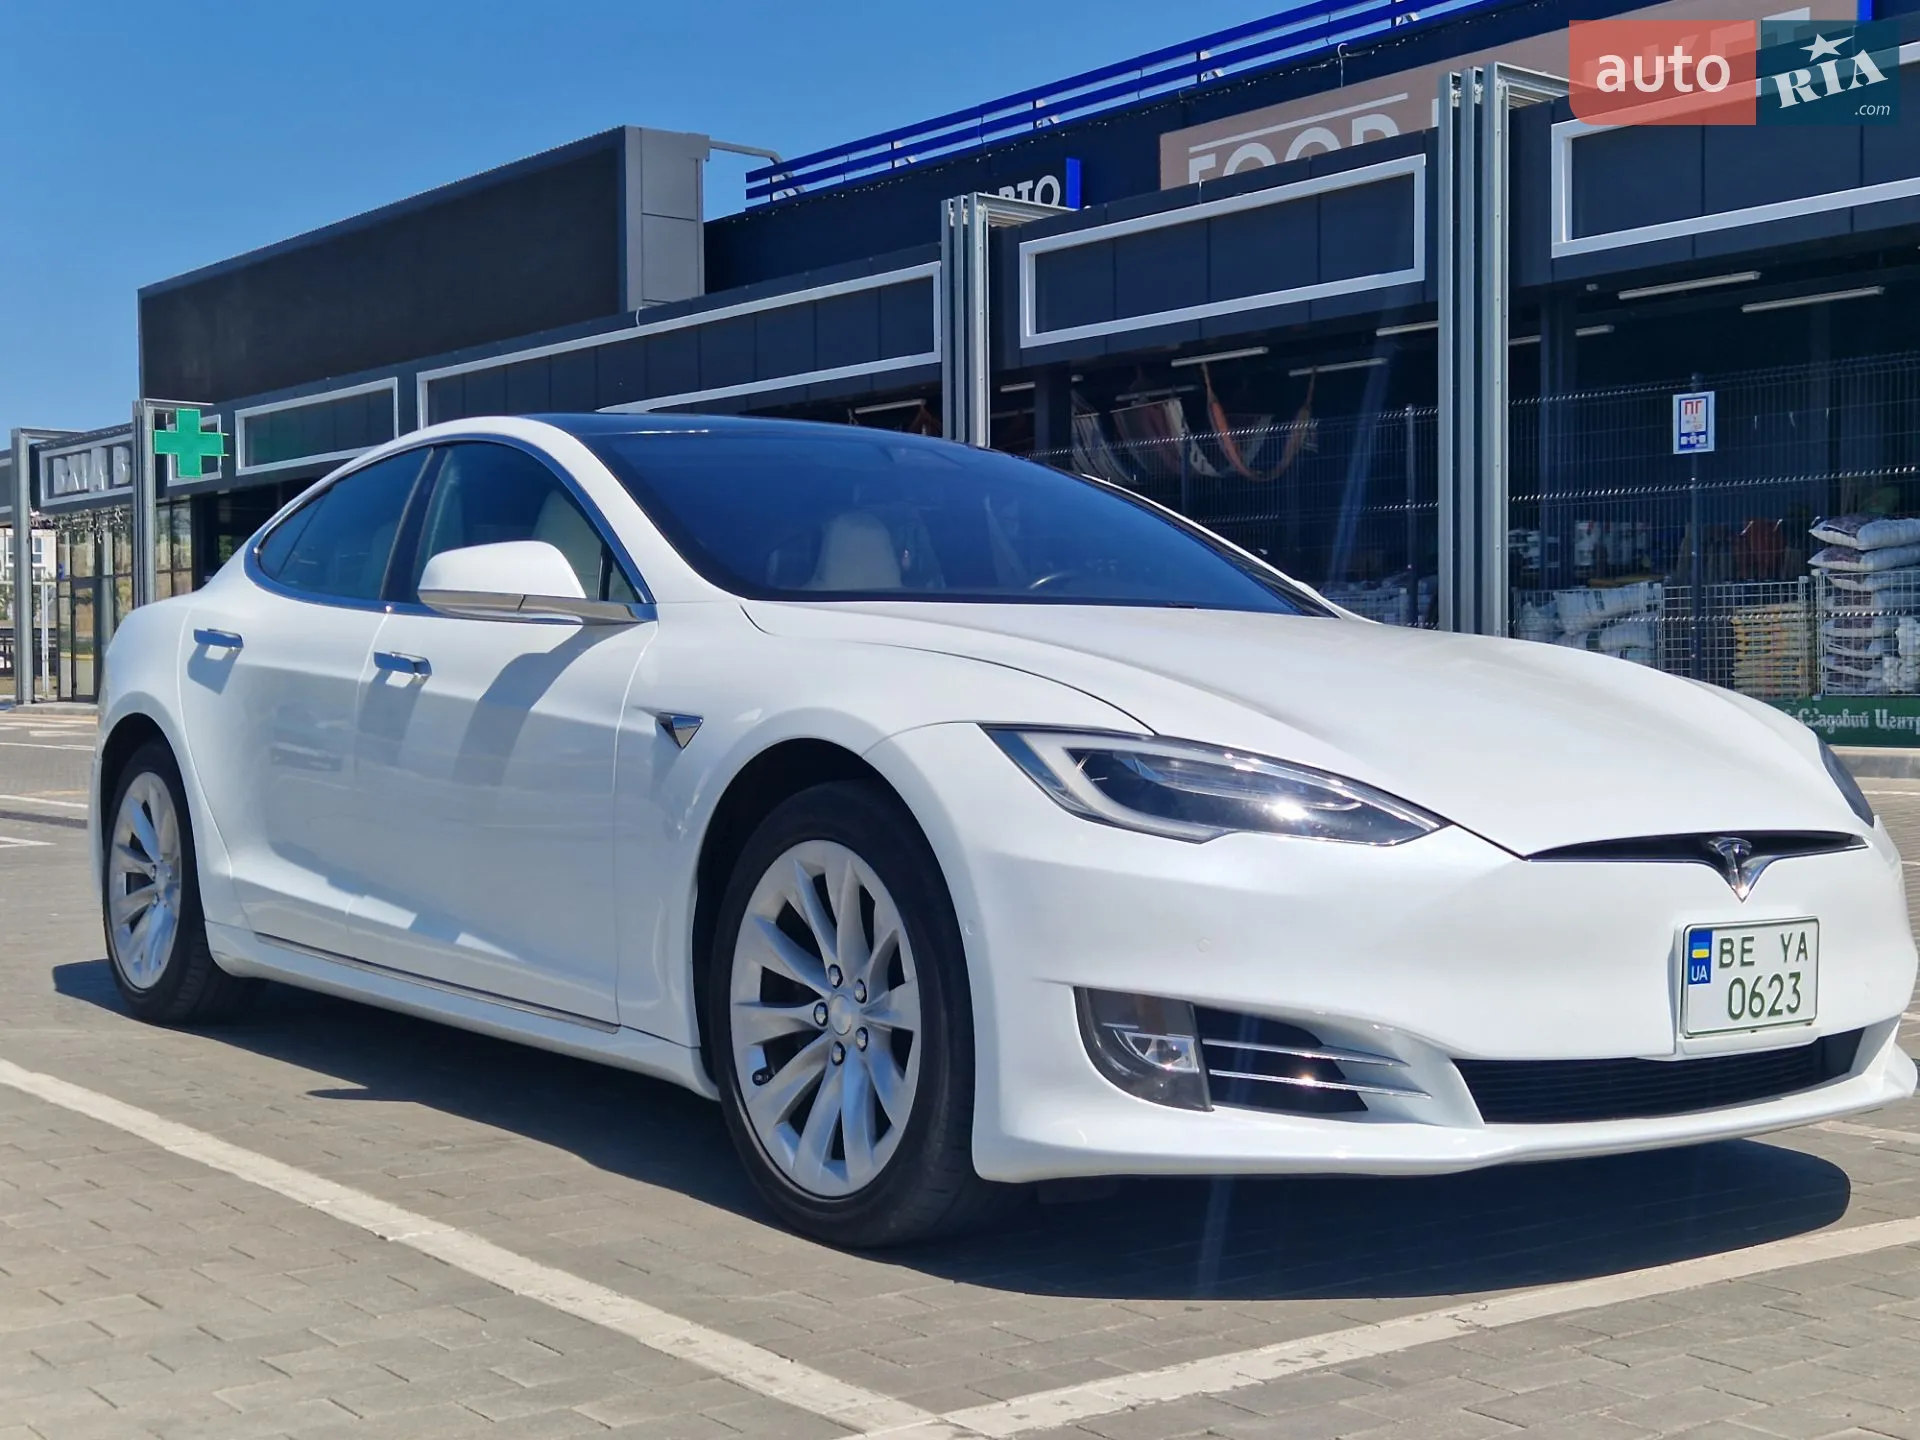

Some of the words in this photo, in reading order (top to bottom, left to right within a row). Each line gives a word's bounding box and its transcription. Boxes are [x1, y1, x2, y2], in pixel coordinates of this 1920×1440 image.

[1718, 936, 1755, 968] BE
[1780, 931, 1808, 963] YA
[1691, 965, 1708, 982] UA
[1727, 971, 1801, 1020] 0623
